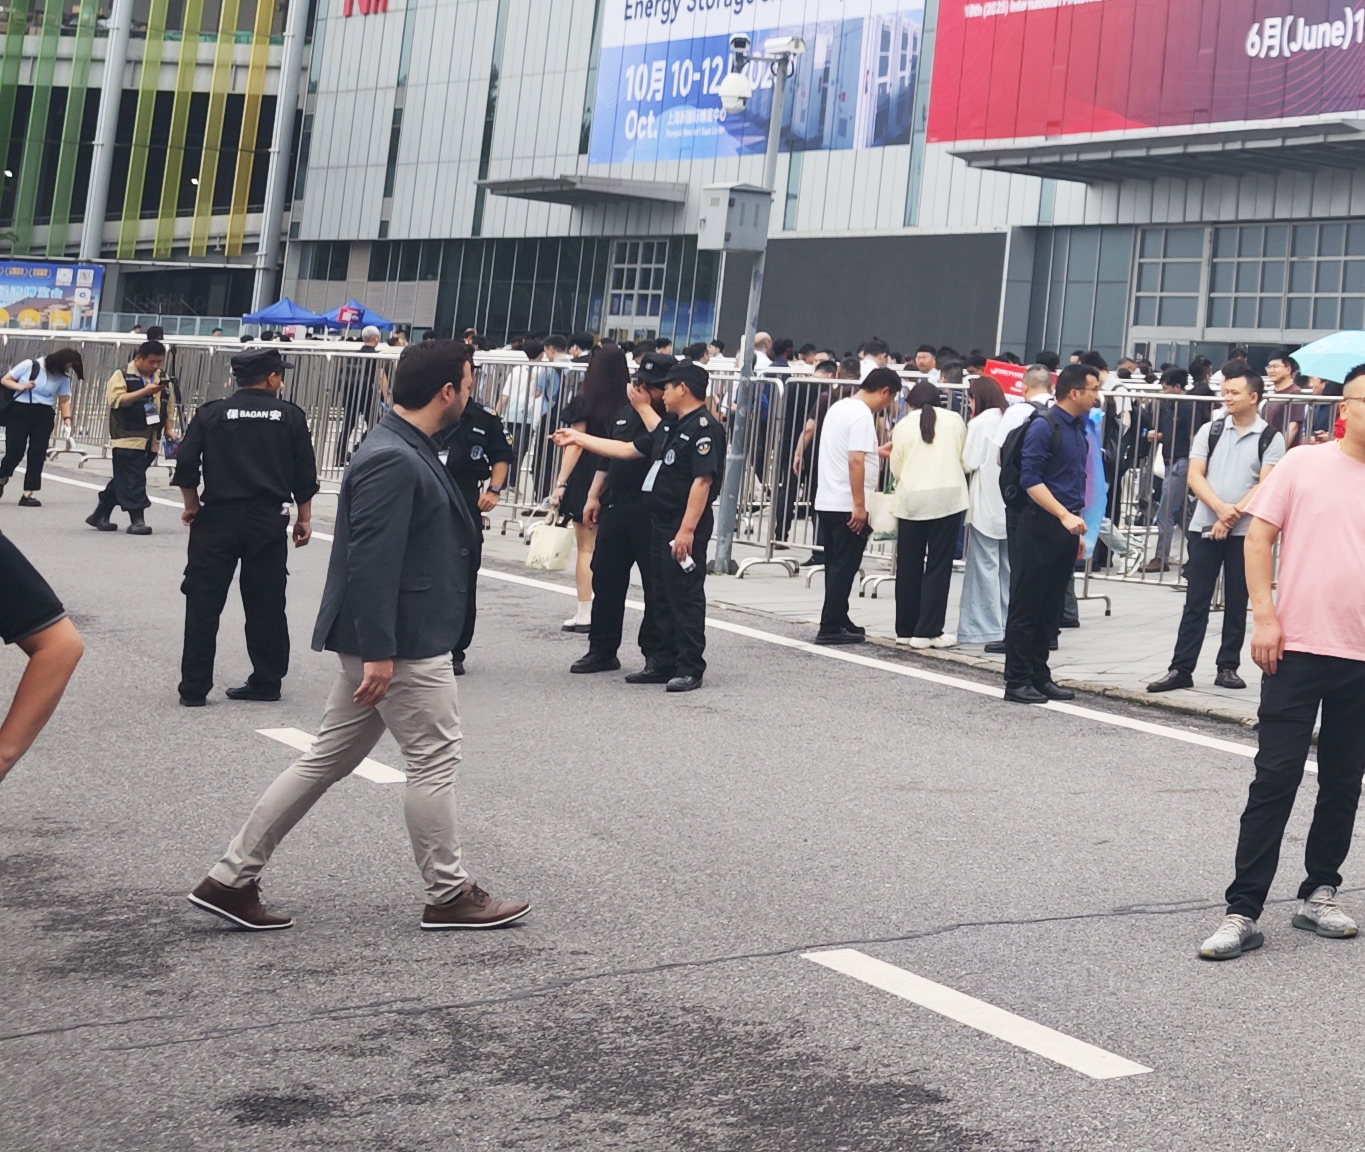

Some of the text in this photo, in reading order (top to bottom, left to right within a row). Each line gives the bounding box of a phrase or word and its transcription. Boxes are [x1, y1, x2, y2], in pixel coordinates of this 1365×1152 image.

[625, 59, 667, 102] 10月
[671, 54, 724, 98] 10-12
[625, 108, 658, 141] Oct.
